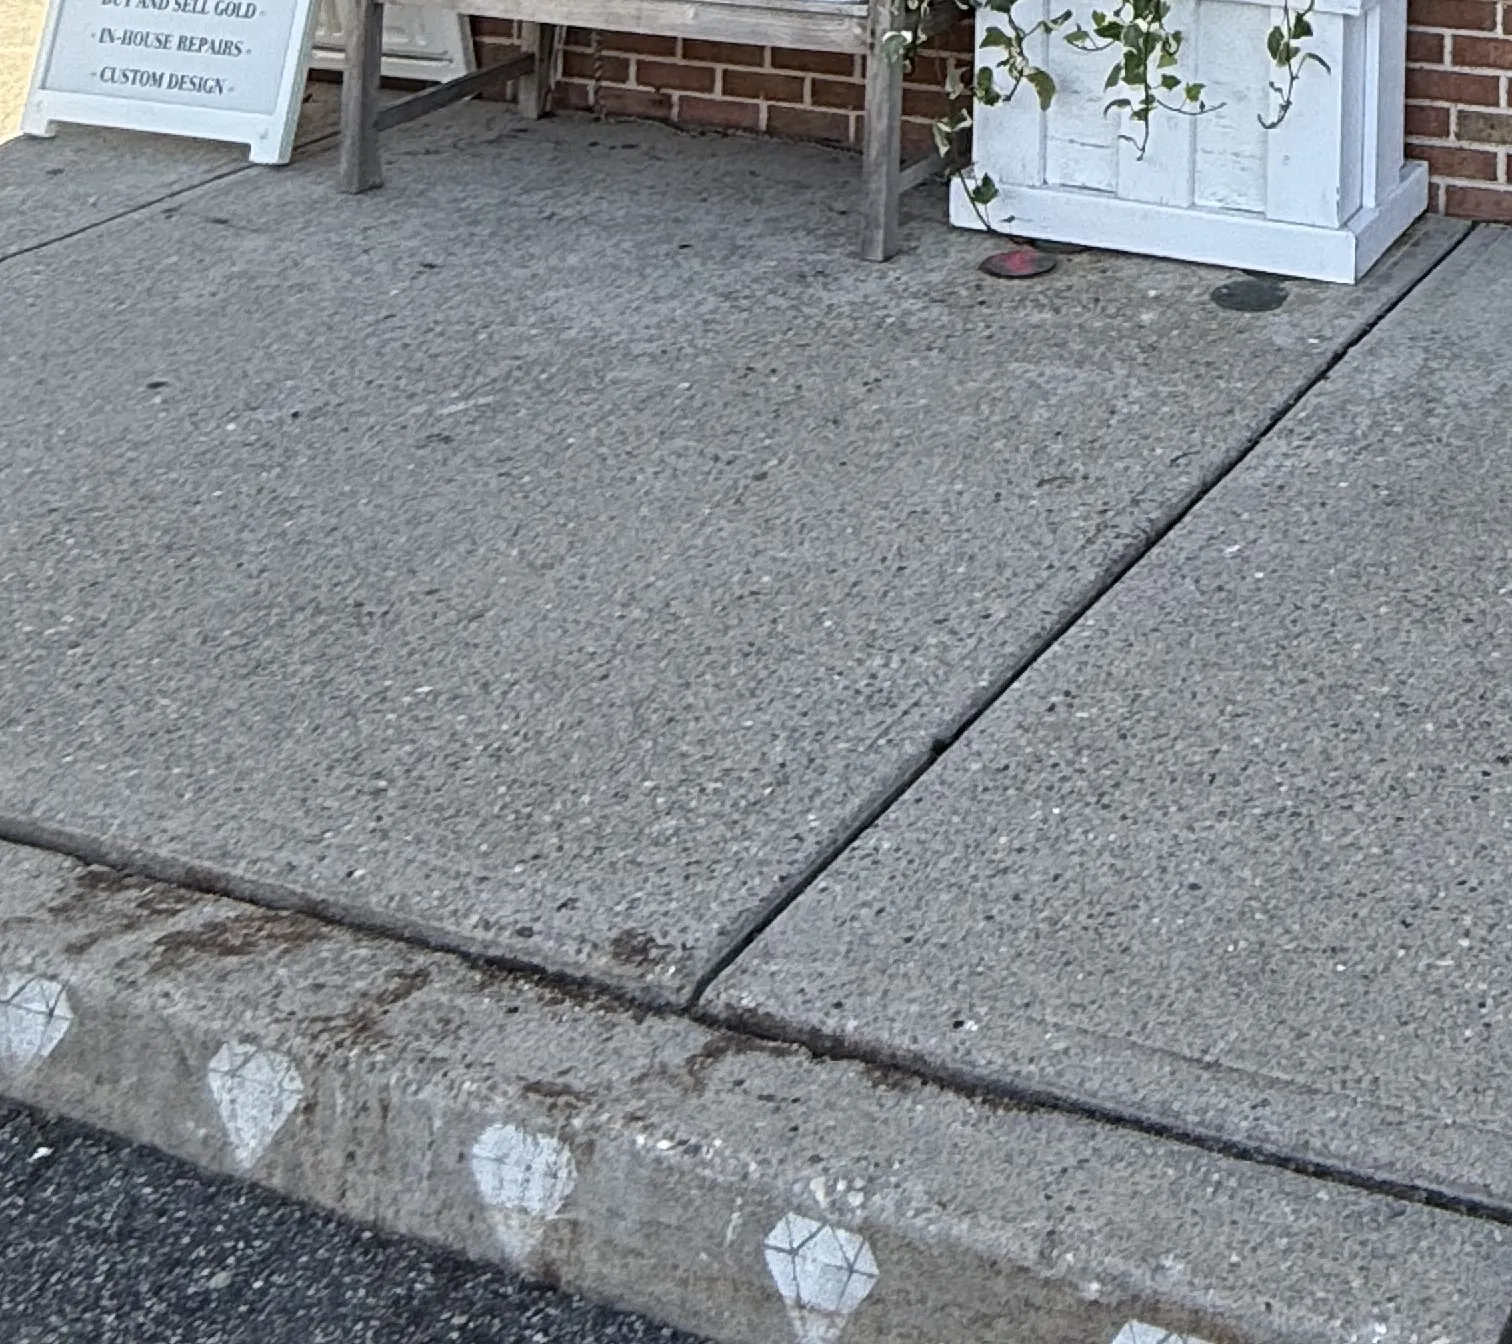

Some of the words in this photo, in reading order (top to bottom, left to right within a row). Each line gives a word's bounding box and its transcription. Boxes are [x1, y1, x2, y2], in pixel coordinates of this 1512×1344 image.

[213, 0, 257, 19] GOLD
[98, 27, 174, 50] IN-HOUSE
[176, 34, 243, 58] REPAIRS
[99, 66, 165, 89] CUSTOM
[166, 73, 227, 96] DESIGN
